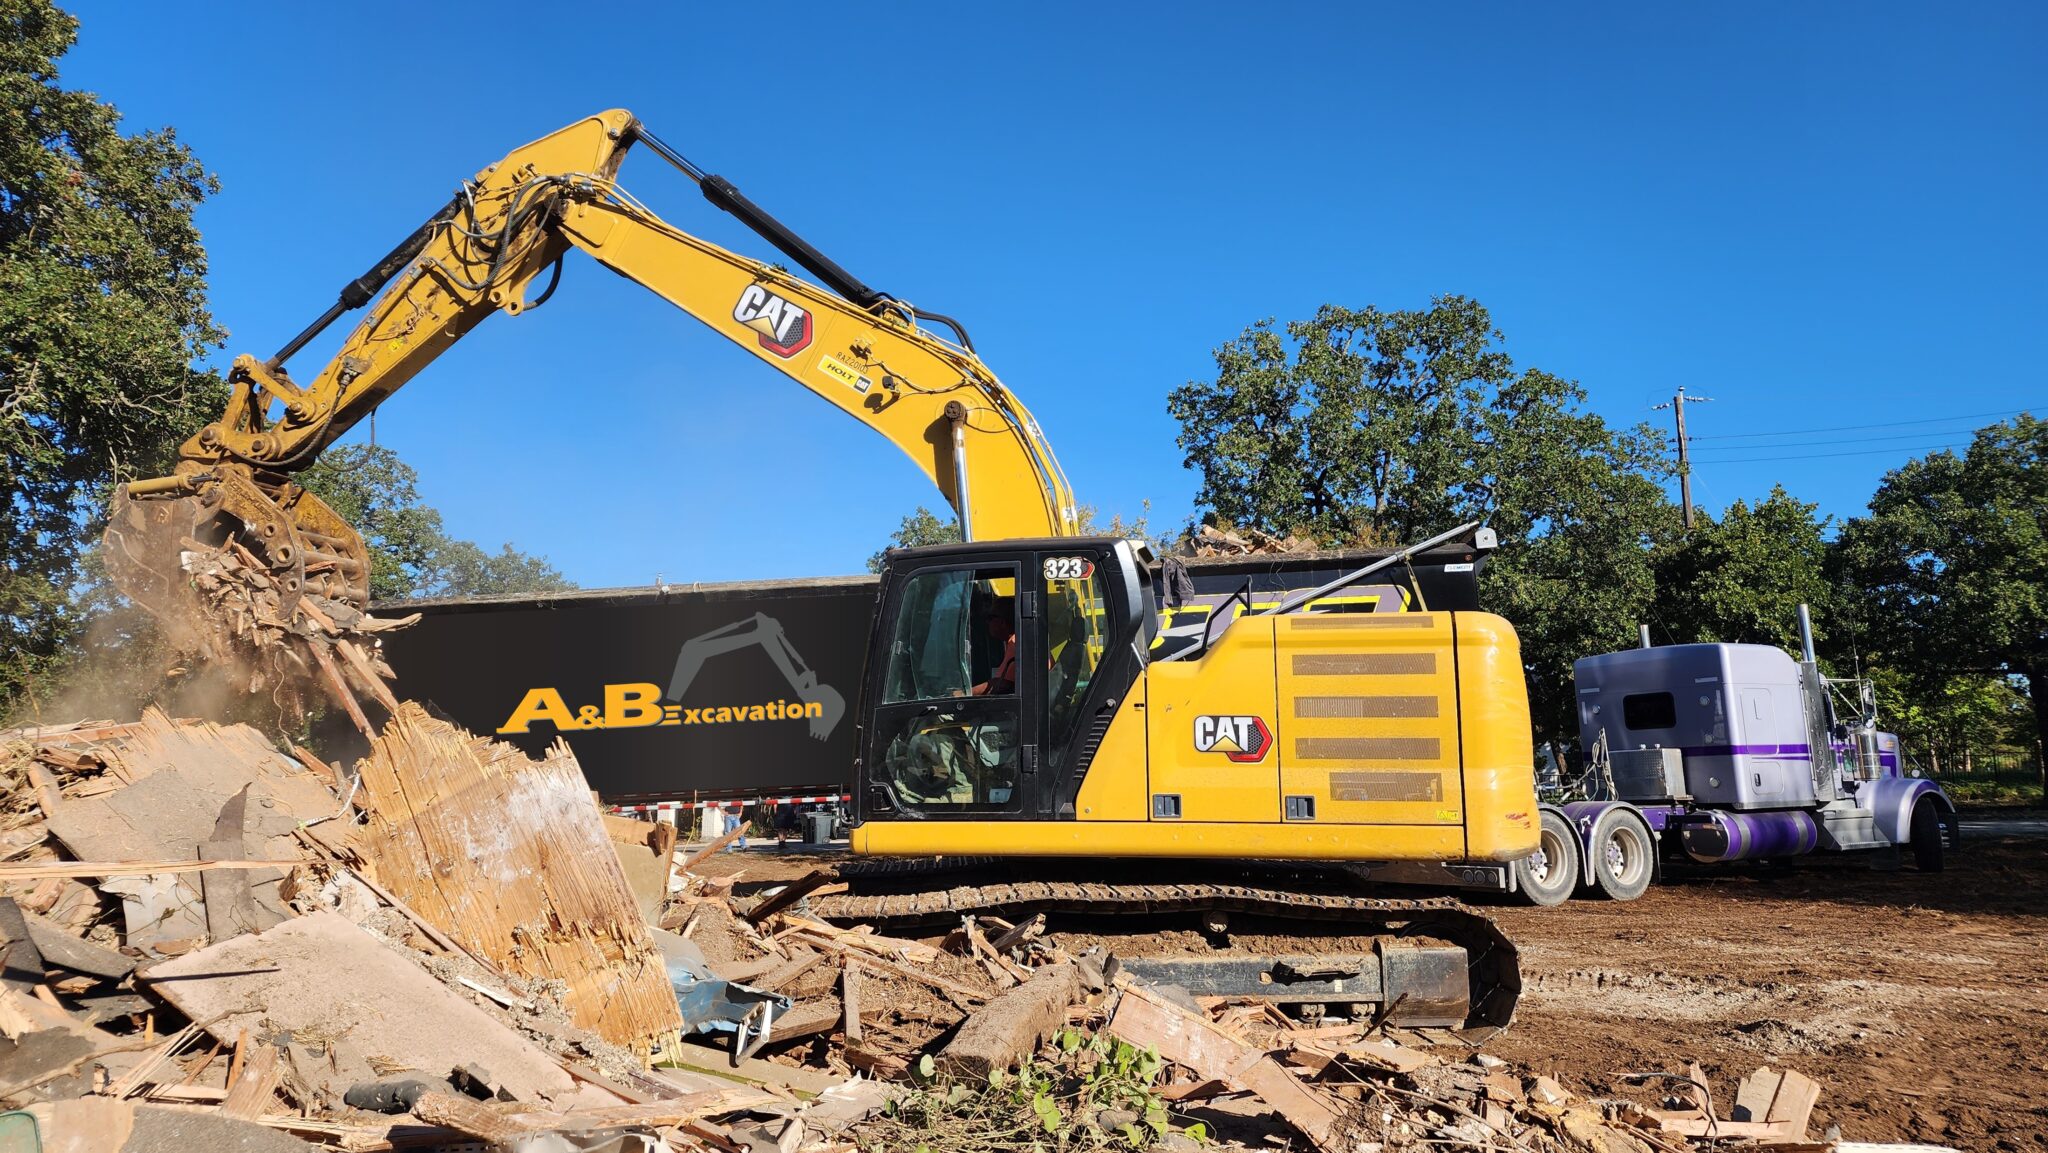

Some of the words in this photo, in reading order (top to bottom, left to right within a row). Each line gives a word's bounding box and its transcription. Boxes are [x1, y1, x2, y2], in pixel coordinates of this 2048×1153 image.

[734, 285, 804, 342] CAT
[827, 363, 855, 380] HOLT
[1045, 558, 1082, 578] 323
[496, 682, 662, 734] A&B
[658, 699, 823, 726] Excavation
[1195, 716, 1252, 751] CAT
